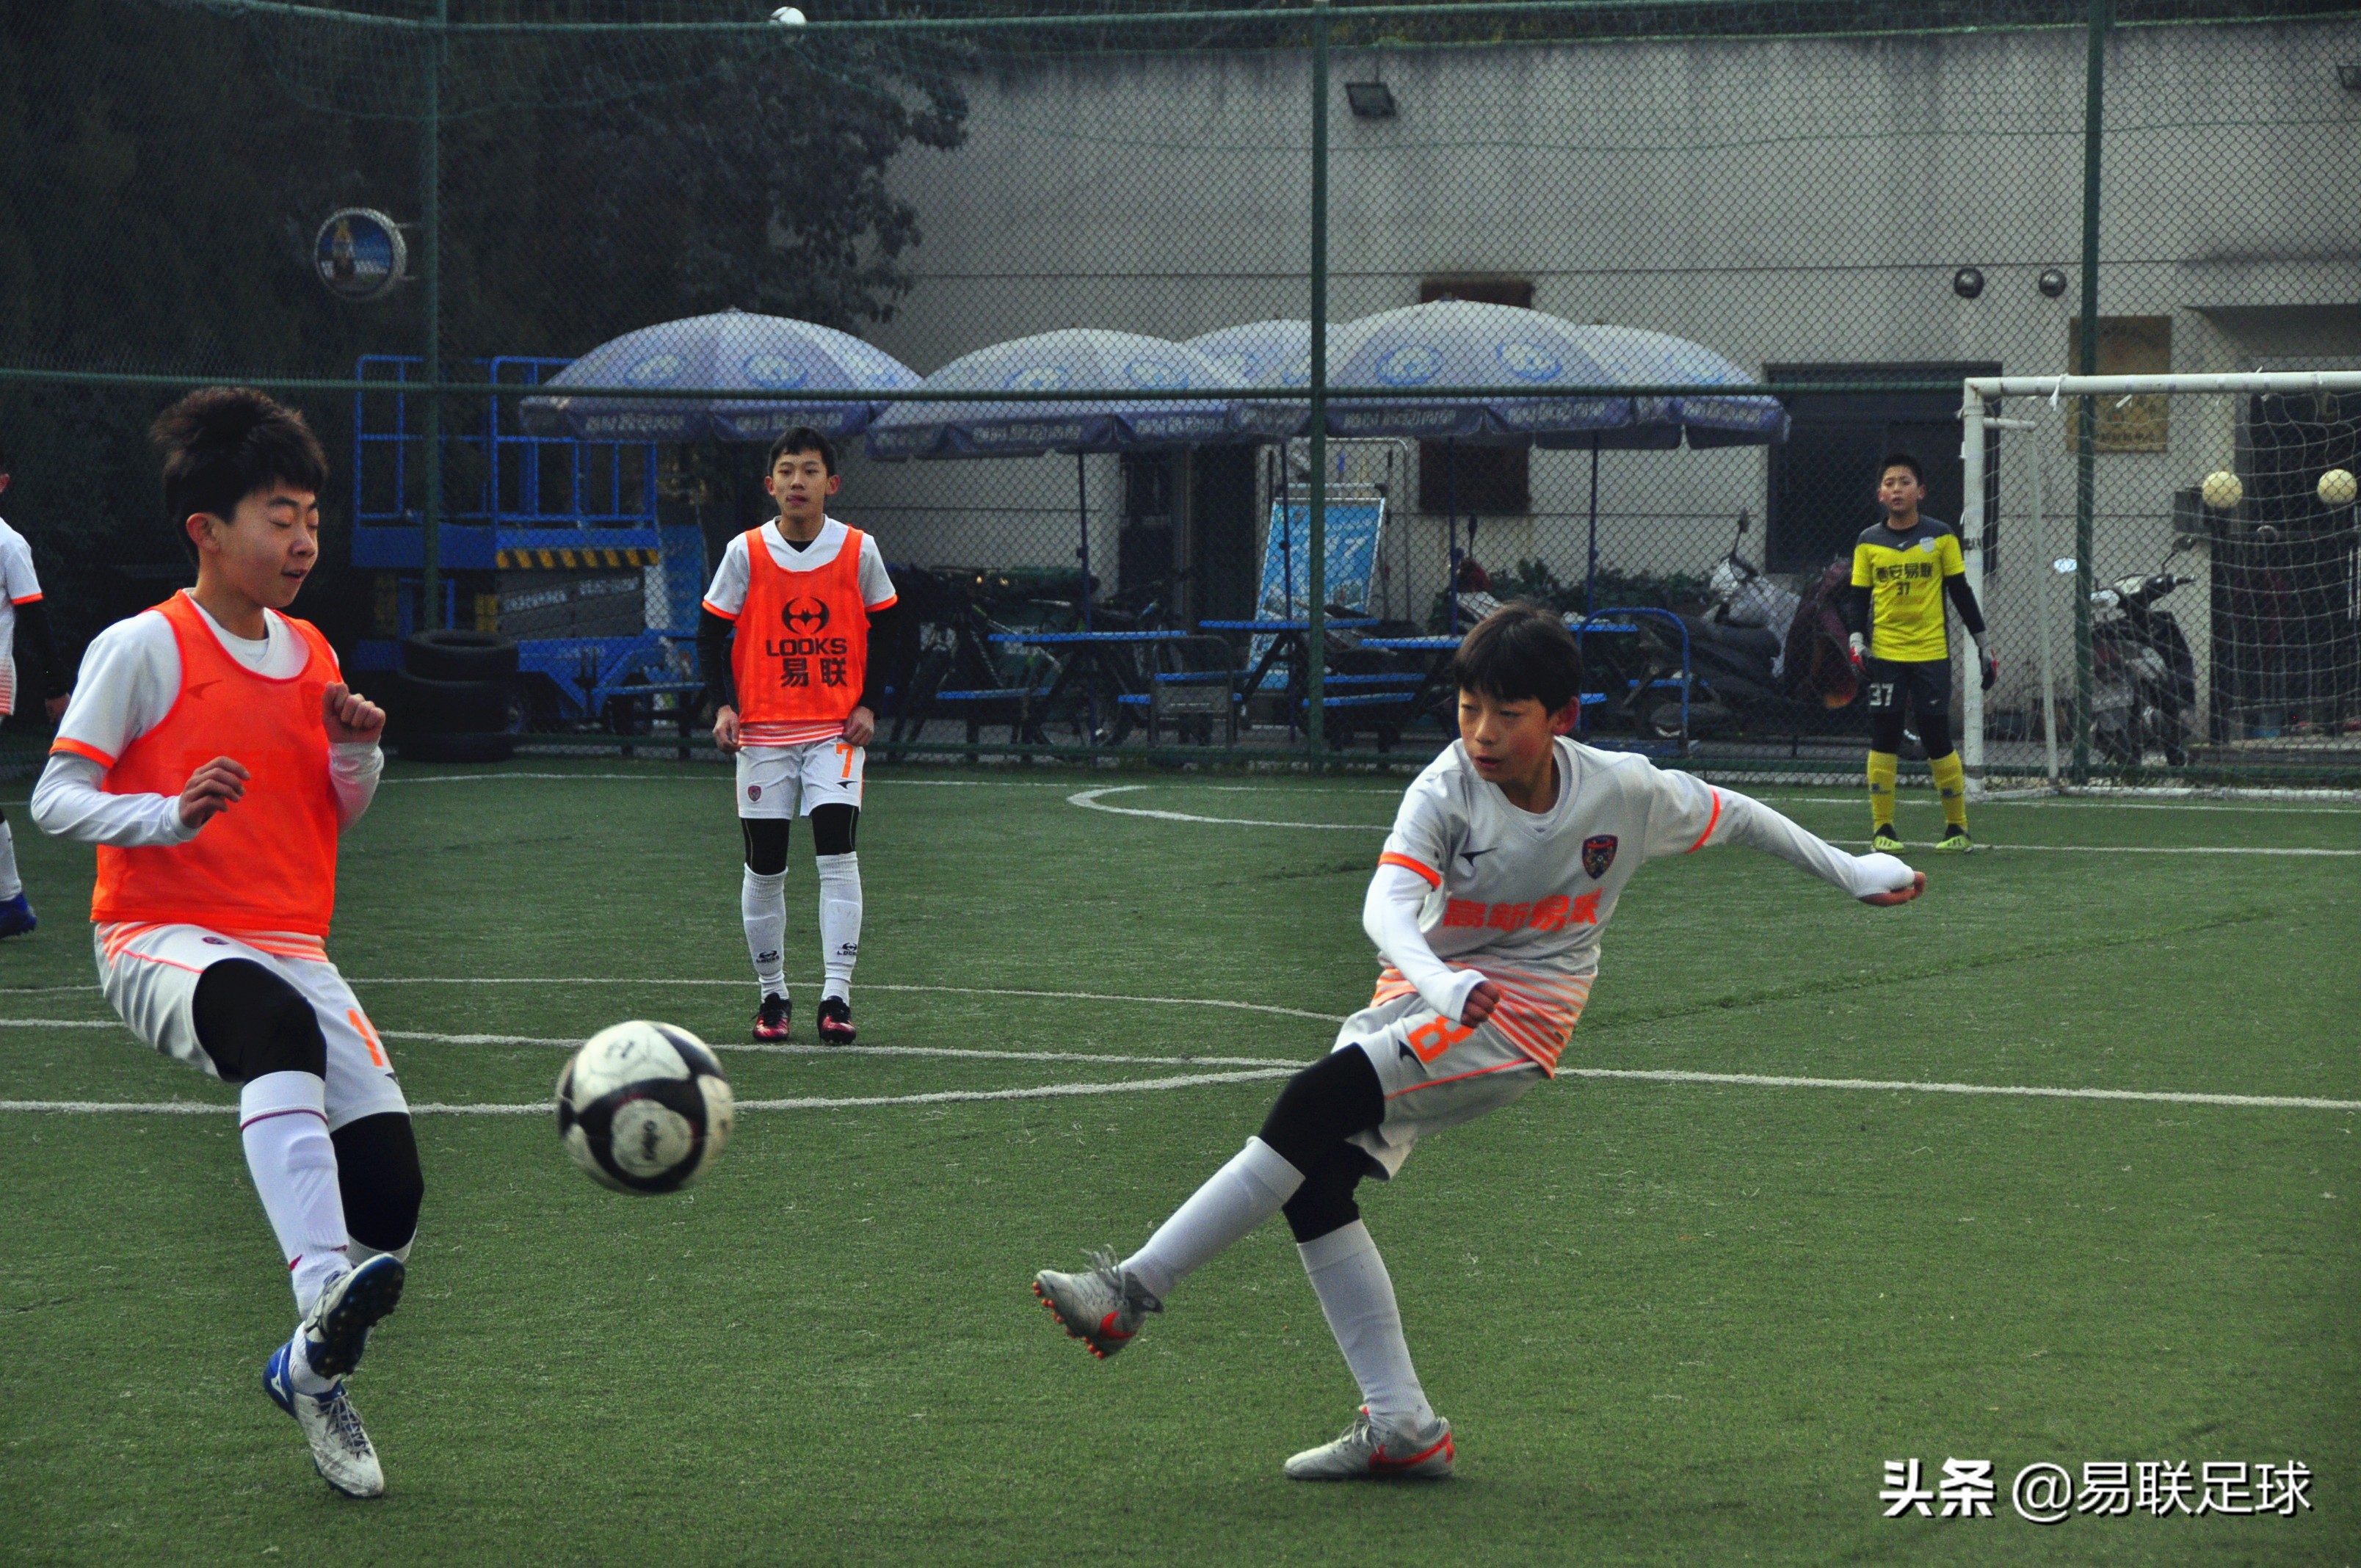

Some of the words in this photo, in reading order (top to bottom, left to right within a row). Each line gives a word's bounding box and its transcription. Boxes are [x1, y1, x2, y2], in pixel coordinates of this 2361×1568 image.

[1896, 581, 1910, 595] 37
[766, 637, 848, 657] LOOKS
[780, 657, 848, 687] 易联
[1869, 683, 1894, 706] 37
[835, 742, 854, 778] 7
[1407, 1015, 1475, 1064] 8
